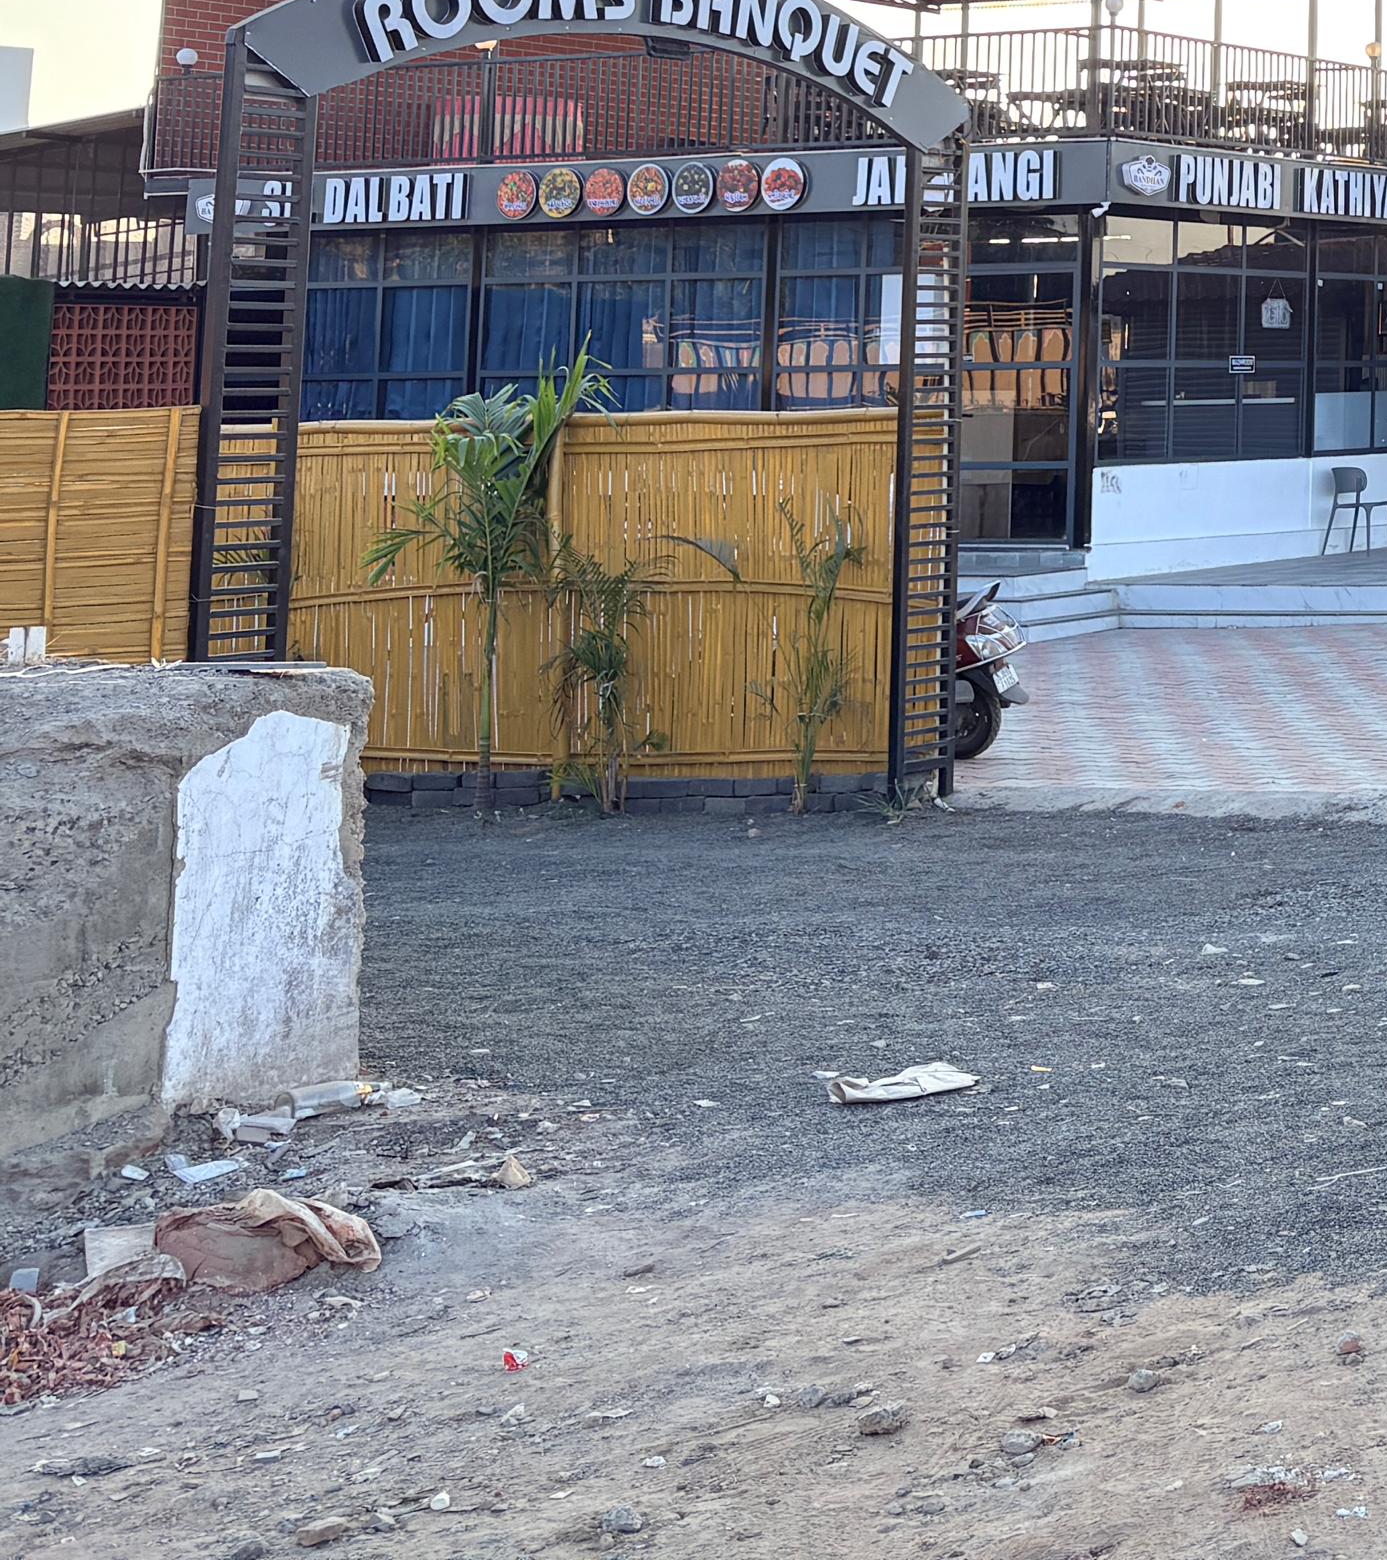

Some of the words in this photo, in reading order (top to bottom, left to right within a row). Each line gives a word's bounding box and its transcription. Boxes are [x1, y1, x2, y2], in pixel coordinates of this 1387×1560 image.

[323, 177, 383, 224] DAL
[387, 172, 465, 222] BATI
[1178, 154, 1281, 210] PUNJABI
